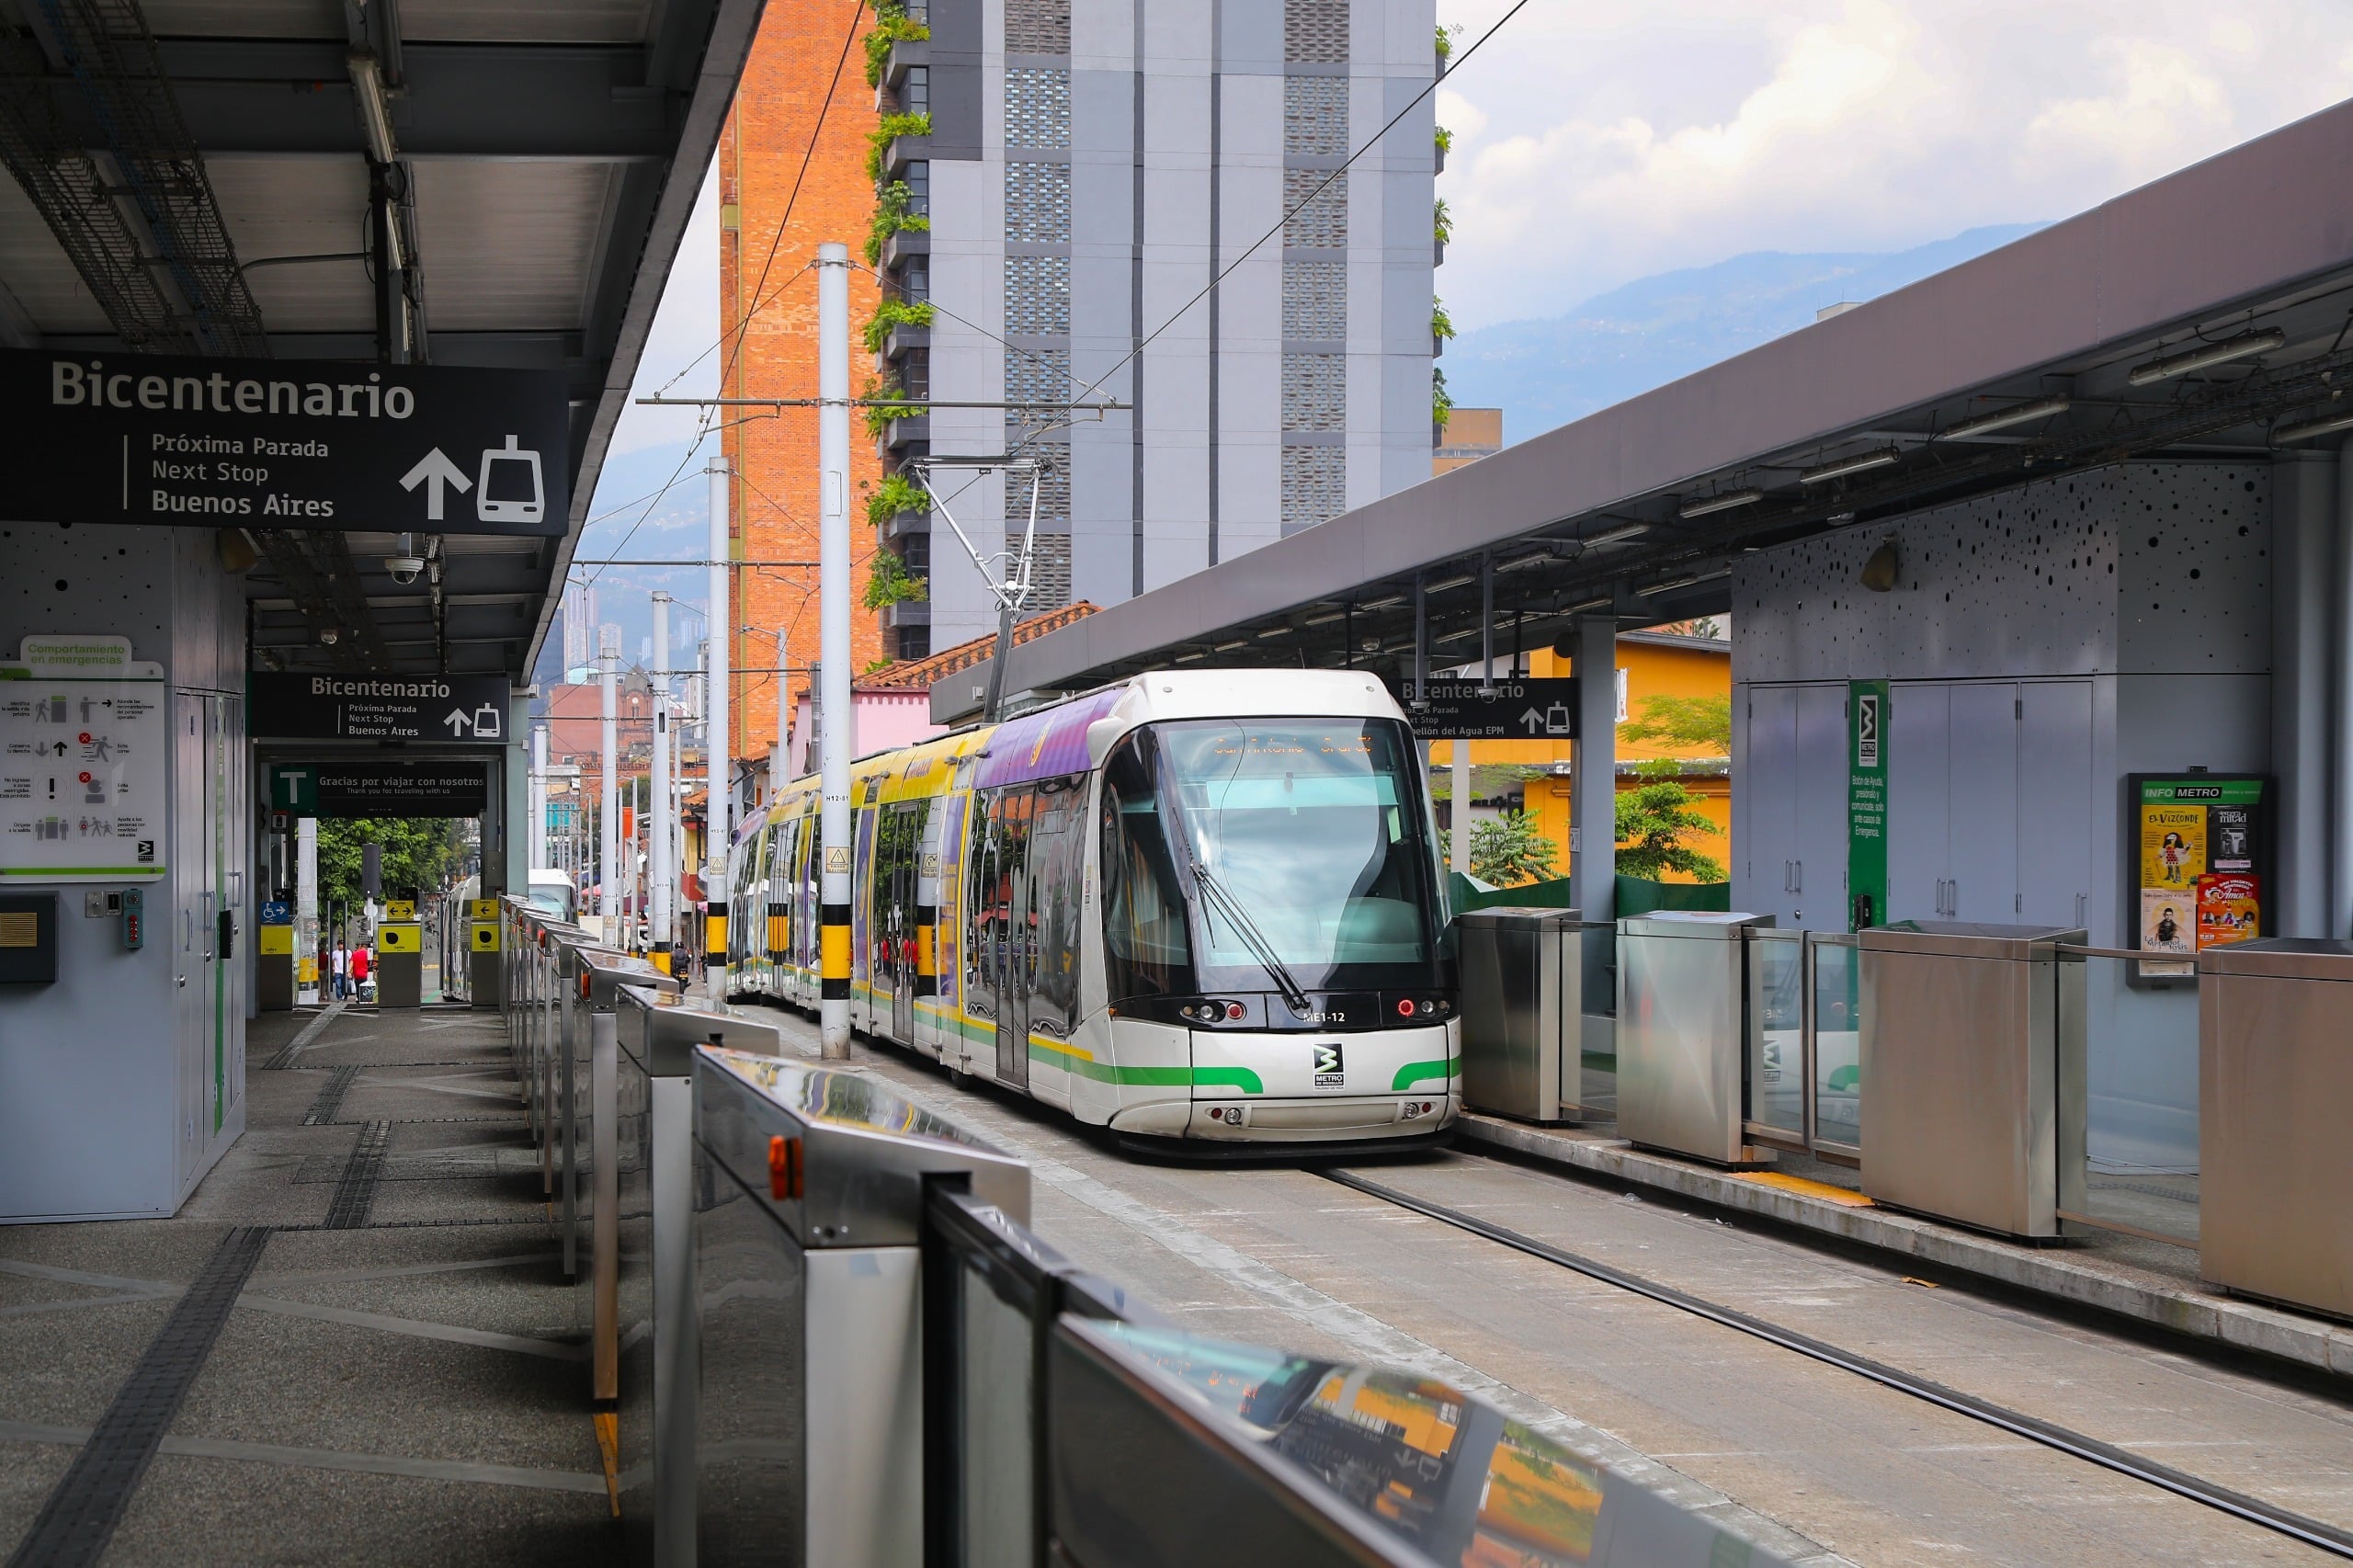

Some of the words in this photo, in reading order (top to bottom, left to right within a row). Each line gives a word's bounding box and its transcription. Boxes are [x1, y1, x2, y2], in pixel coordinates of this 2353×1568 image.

[52, 360, 415, 419] Bicentenario
[152, 433, 244, 455] Próxima
[254, 437, 329, 458] Parada
[152, 460, 210, 482] Next
[217, 462, 268, 486] Stop
[152, 489, 252, 515] Buenos
[263, 494, 335, 517] Aires
[28, 643, 125, 655] Comportamiento
[31, 655, 45, 664] en
[49, 655, 123, 666] emergencias
[312, 676, 450, 698] Bicentenario
[348, 703, 384, 712] Próxima
[387, 705, 417, 713] Parada
[348, 714, 370, 722] Next
[373, 714, 394, 724] Stop
[348, 725, 387, 735] Buenos
[392, 726, 419, 736] Aires
[1441, 726, 1456, 735] del
[1460, 727, 1483, 736] Agua
[1486, 726, 1505, 735] EPM
[280, 772, 306, 803] T
[320, 777, 358, 786] Gracias
[362, 778, 379, 788] por
[383, 777, 414, 788] viajar
[439, 778, 484, 786] nosotros
[2146, 789, 2173, 797] INFO
[2177, 789, 2220, 797] METRO
[1303, 1012, 1345, 1022] ME1-12
